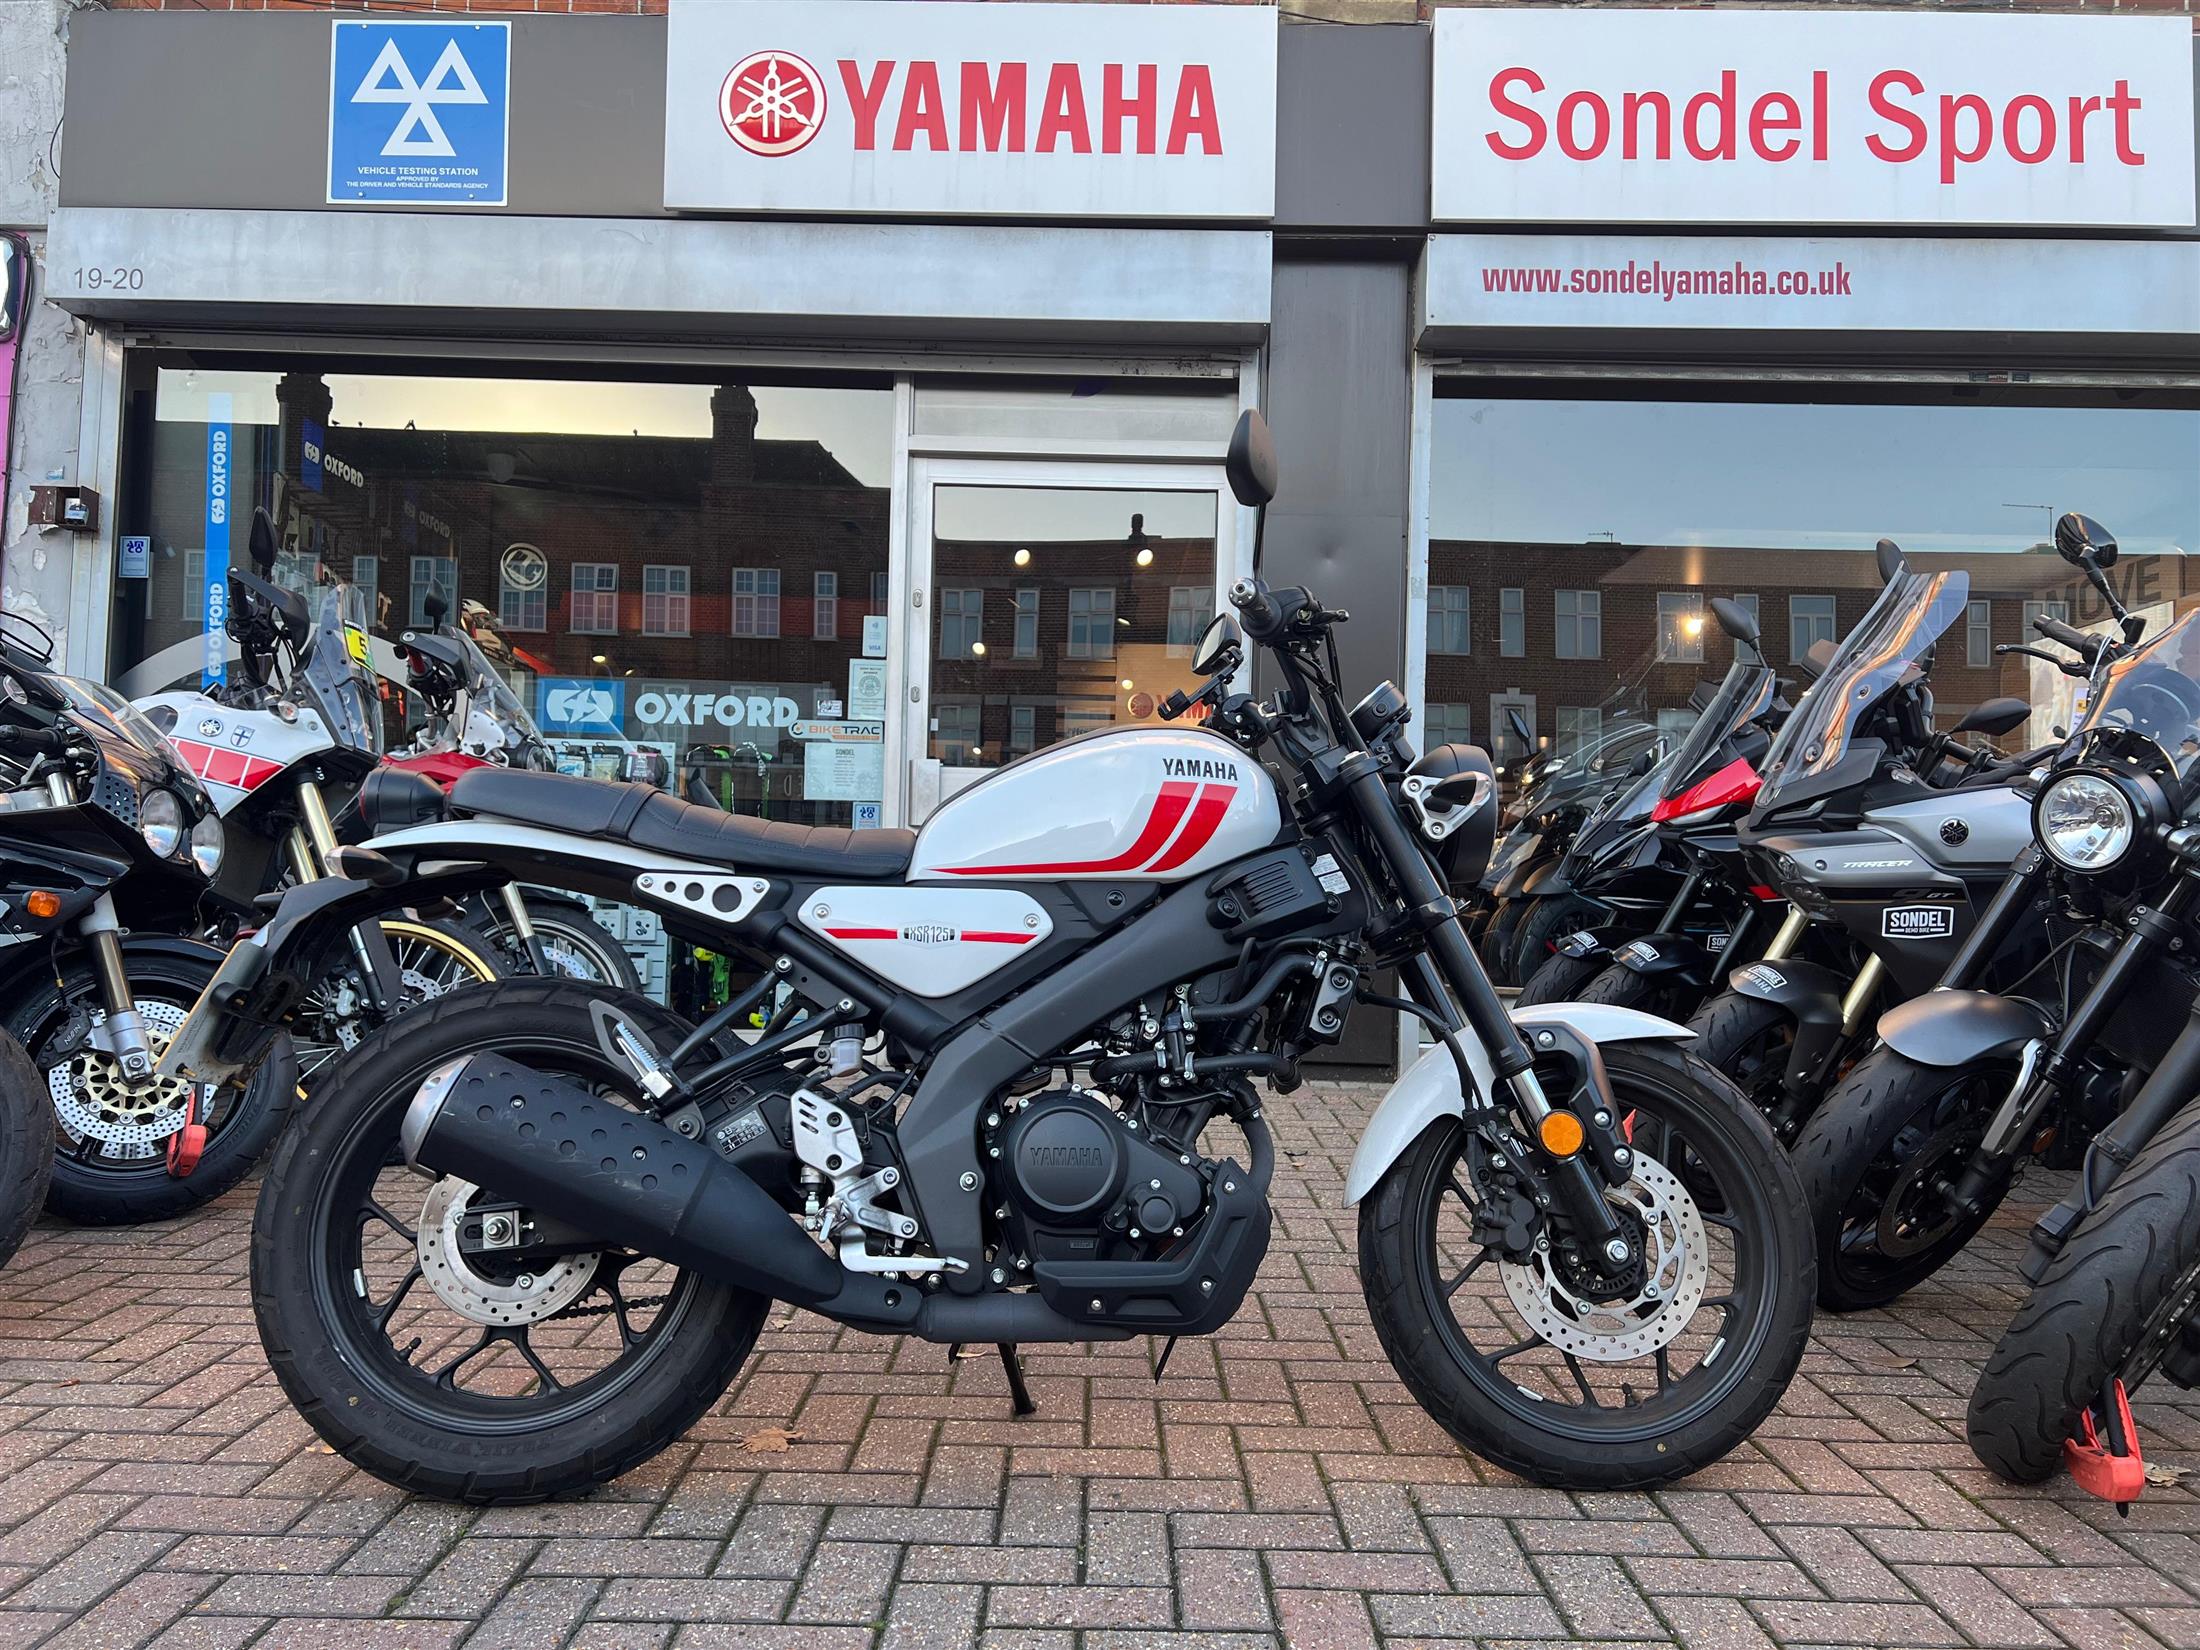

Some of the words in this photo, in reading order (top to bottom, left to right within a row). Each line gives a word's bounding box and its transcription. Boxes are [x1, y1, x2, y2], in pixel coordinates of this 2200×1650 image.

[837, 60, 1223, 155] YAMAHA
[1484, 66, 1828, 163] Sondel
[1864, 68, 2146, 185] Sport
[357, 166, 396, 175] VEHICLE
[398, 167, 437, 175] TESTING
[439, 167, 479, 176] STATION
[74, 267, 144, 290] 19-20
[1482, 260, 1852, 302] www.sondelyamaha.co.uk
[211, 430, 227, 496] OXFORD
[324, 453, 364, 488] OXFORD
[418, 510, 451, 539] OXFORD
[2045, 555, 2162, 626] MOVE
[209, 583, 224, 650] OXFORD
[634, 692, 800, 728] OXFORD
[808, 725, 881, 735] BIKETRAC
[1162, 758, 1238, 781] YAMAHA
[1843, 860, 1913, 869] TRACER
[1889, 911, 1946, 928] SONDEL
[1711, 937, 1729, 947] SON
[1030, 1147, 1104, 1167] YAMAHA
